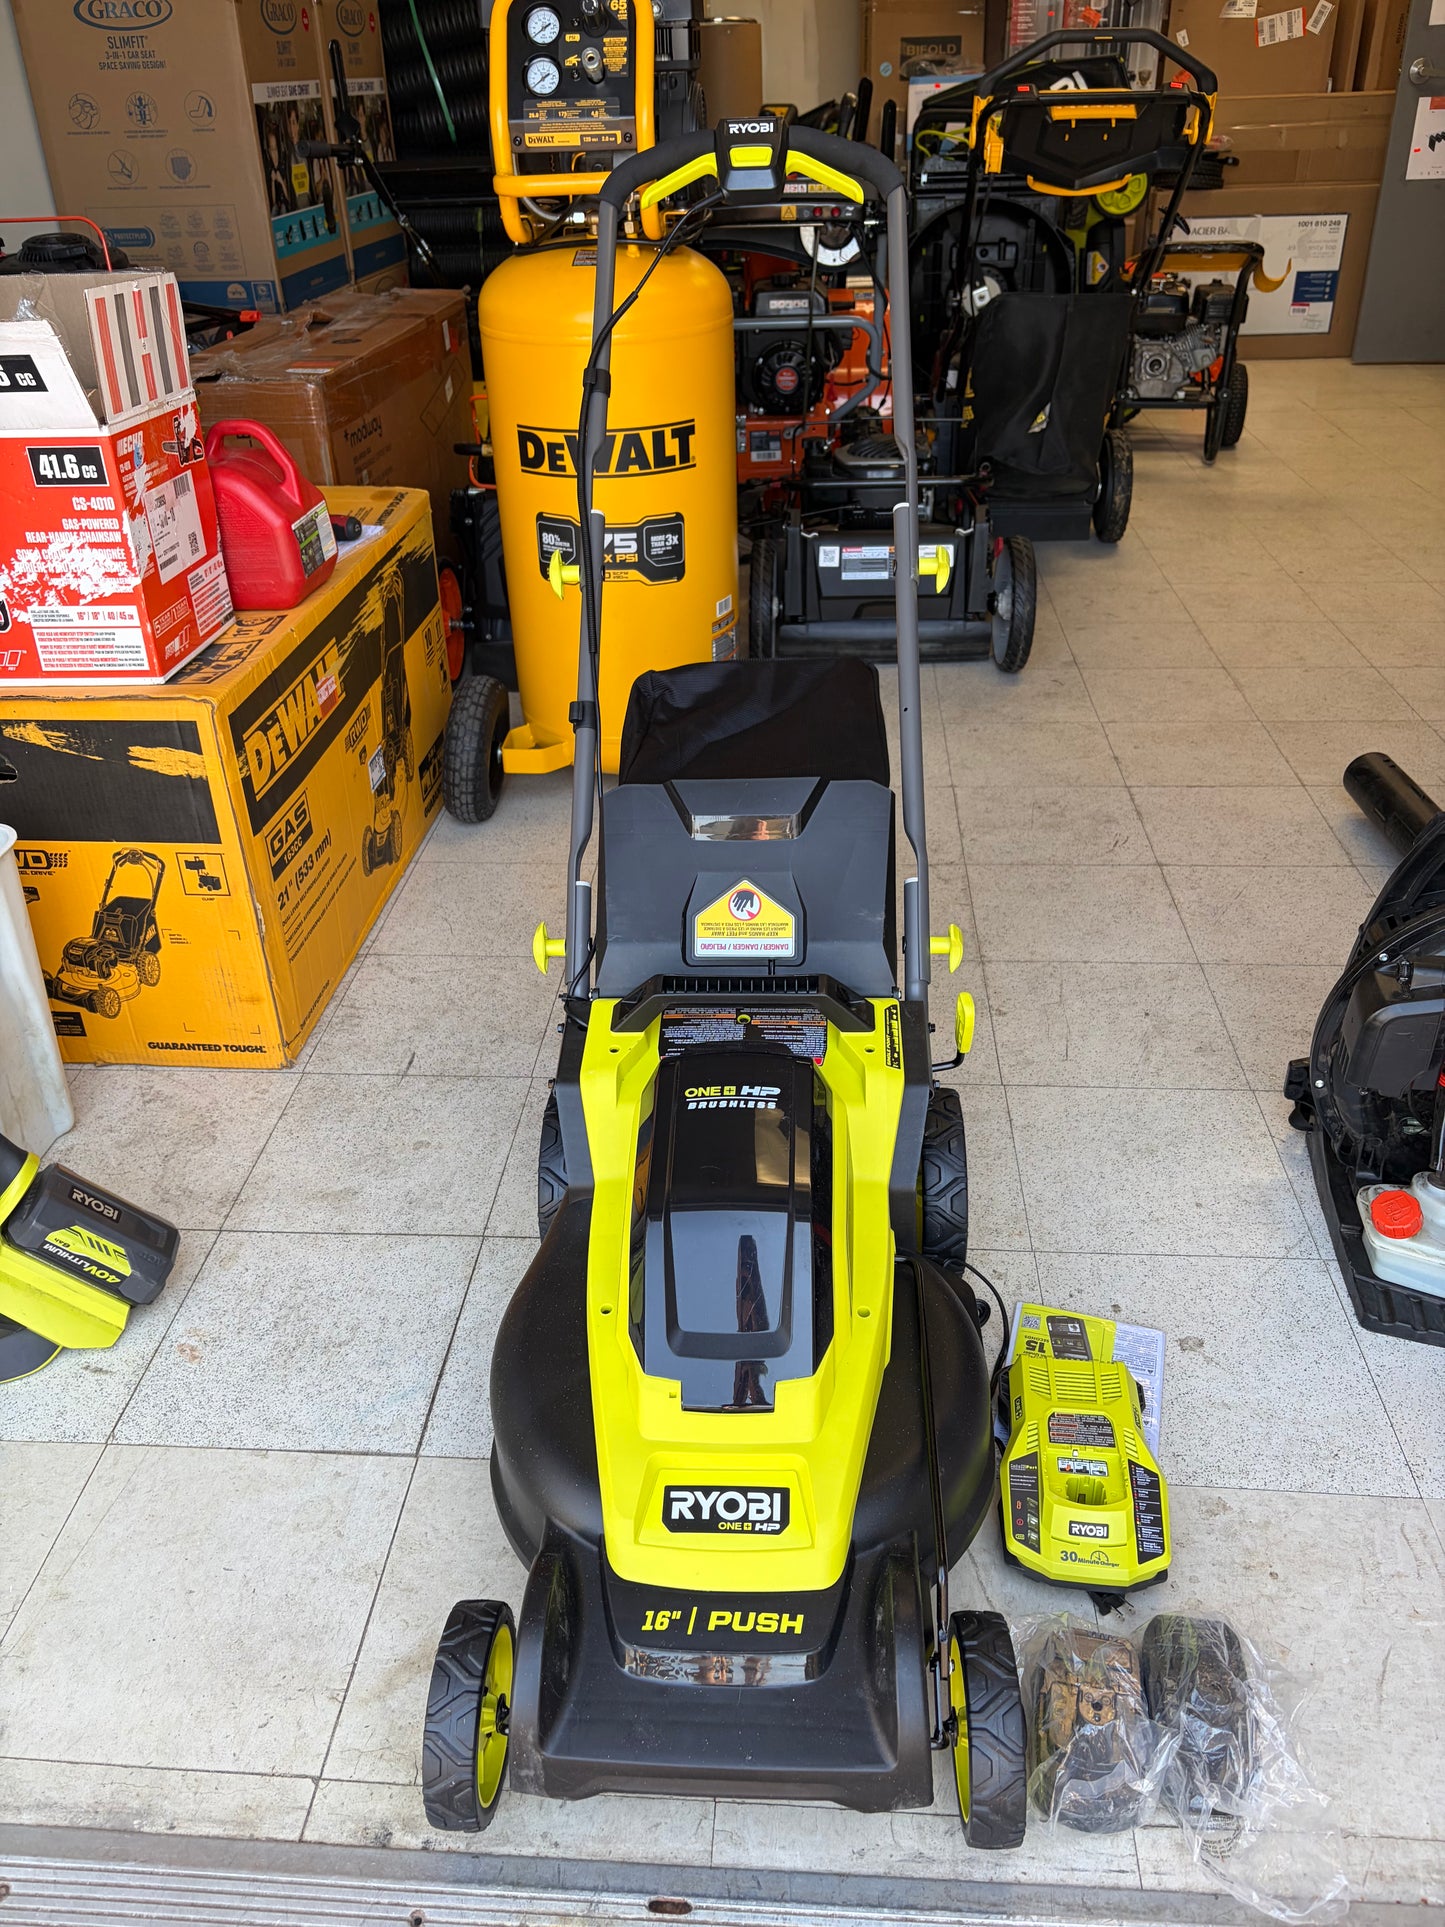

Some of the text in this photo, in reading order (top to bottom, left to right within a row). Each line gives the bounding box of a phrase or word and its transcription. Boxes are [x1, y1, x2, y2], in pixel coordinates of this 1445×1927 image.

[88, 0, 161, 19] GRACO
[266, 0, 294, 21] GRACO
[610, 0, 627, 10] 65
[127, 50, 140, 59] CAR
[141, 49, 156, 59] SEAT
[902, 43, 957, 56] BIFOLD
[98, 61, 119, 70] SPACE
[119, 61, 142, 70] SAVING
[729, 122, 774, 134] RYOBI
[528, 136, 555, 144] DEWALT
[1328, 219, 1342, 227] 249
[1191, 227, 1216, 236] ACIER
[517, 424, 695, 474] DEWALT
[39, 453, 80, 479] 41.6
[71, 496, 116, 511] CS-4010
[61, 517, 120, 530] GAS-POWERED
[79, 531, 122, 543] CHAINSAW
[541, 532, 561, 545] 80%
[650, 534, 666, 542] MORE
[616, 554, 639, 563] PSI
[107, 611, 116, 621] 40
[119, 611, 128, 621] 45
[270, 800, 308, 859] GAS
[283, 836, 303, 866] 163CC
[277, 828, 332, 912] 21" (533 mm)
[732, 943, 759, 951] DANGER
[764, 943, 789, 951] DANGER
[148, 1041, 222, 1052] GUARANTEED
[740, 1085, 782, 1097] HP
[687, 1100, 777, 1110] BRUSHLESS
[71, 1187, 120, 1221] RYOBI
[1024, 1340, 1047, 1354] 15
[670, 1490, 781, 1522] RYOBI
[755, 1522, 781, 1532] HP
[1071, 1523, 1108, 1537] RYOBI
[1060, 1550, 1078, 1562] 30
[641, 1610, 682, 1631] 16"
[707, 1611, 804, 1634] PUSH
